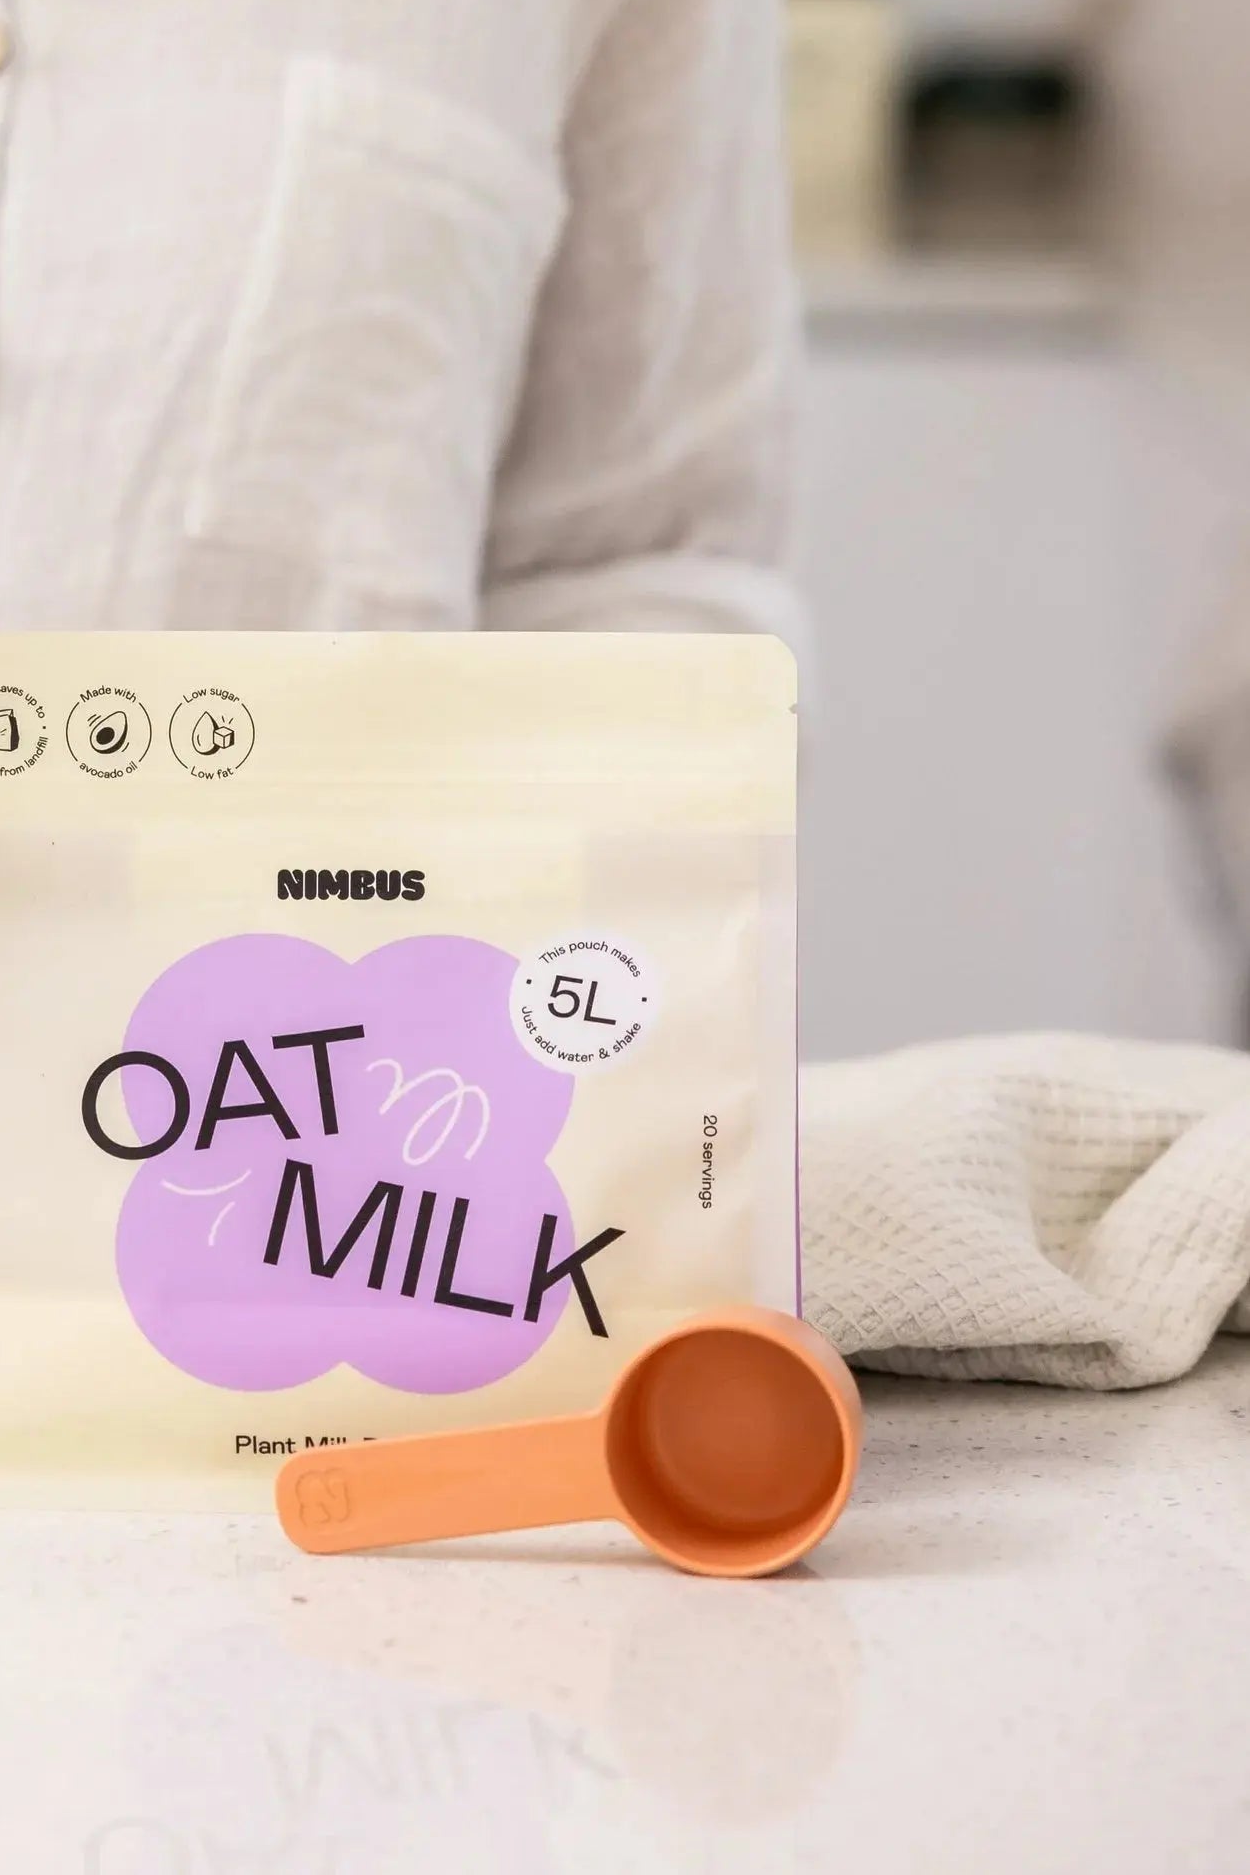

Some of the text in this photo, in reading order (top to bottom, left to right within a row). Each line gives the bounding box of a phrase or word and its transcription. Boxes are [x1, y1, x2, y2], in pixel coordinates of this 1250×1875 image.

[24, 693, 38, 707] up
[35, 706, 46, 719] to
[79, 685, 138, 703] Made with
[182, 687, 241, 704] Low sugar
[0, 765, 25, 777] from
[23, 736, 49, 768] landfill
[79, 760, 138, 780] avocado oil
[190, 765, 235, 780] Low fat
[277, 869, 426, 901] NIMBUS
[538, 940, 642, 978] This pouch makes
[547, 974, 617, 1026] 5L
[521, 1006, 642, 1063] Just add water & shake
[81, 1023, 365, 1161] OAT
[698, 1114, 718, 1209] 20 servings
[262, 1157, 626, 1339] MILK
[235, 1435, 297, 1455] Plant
